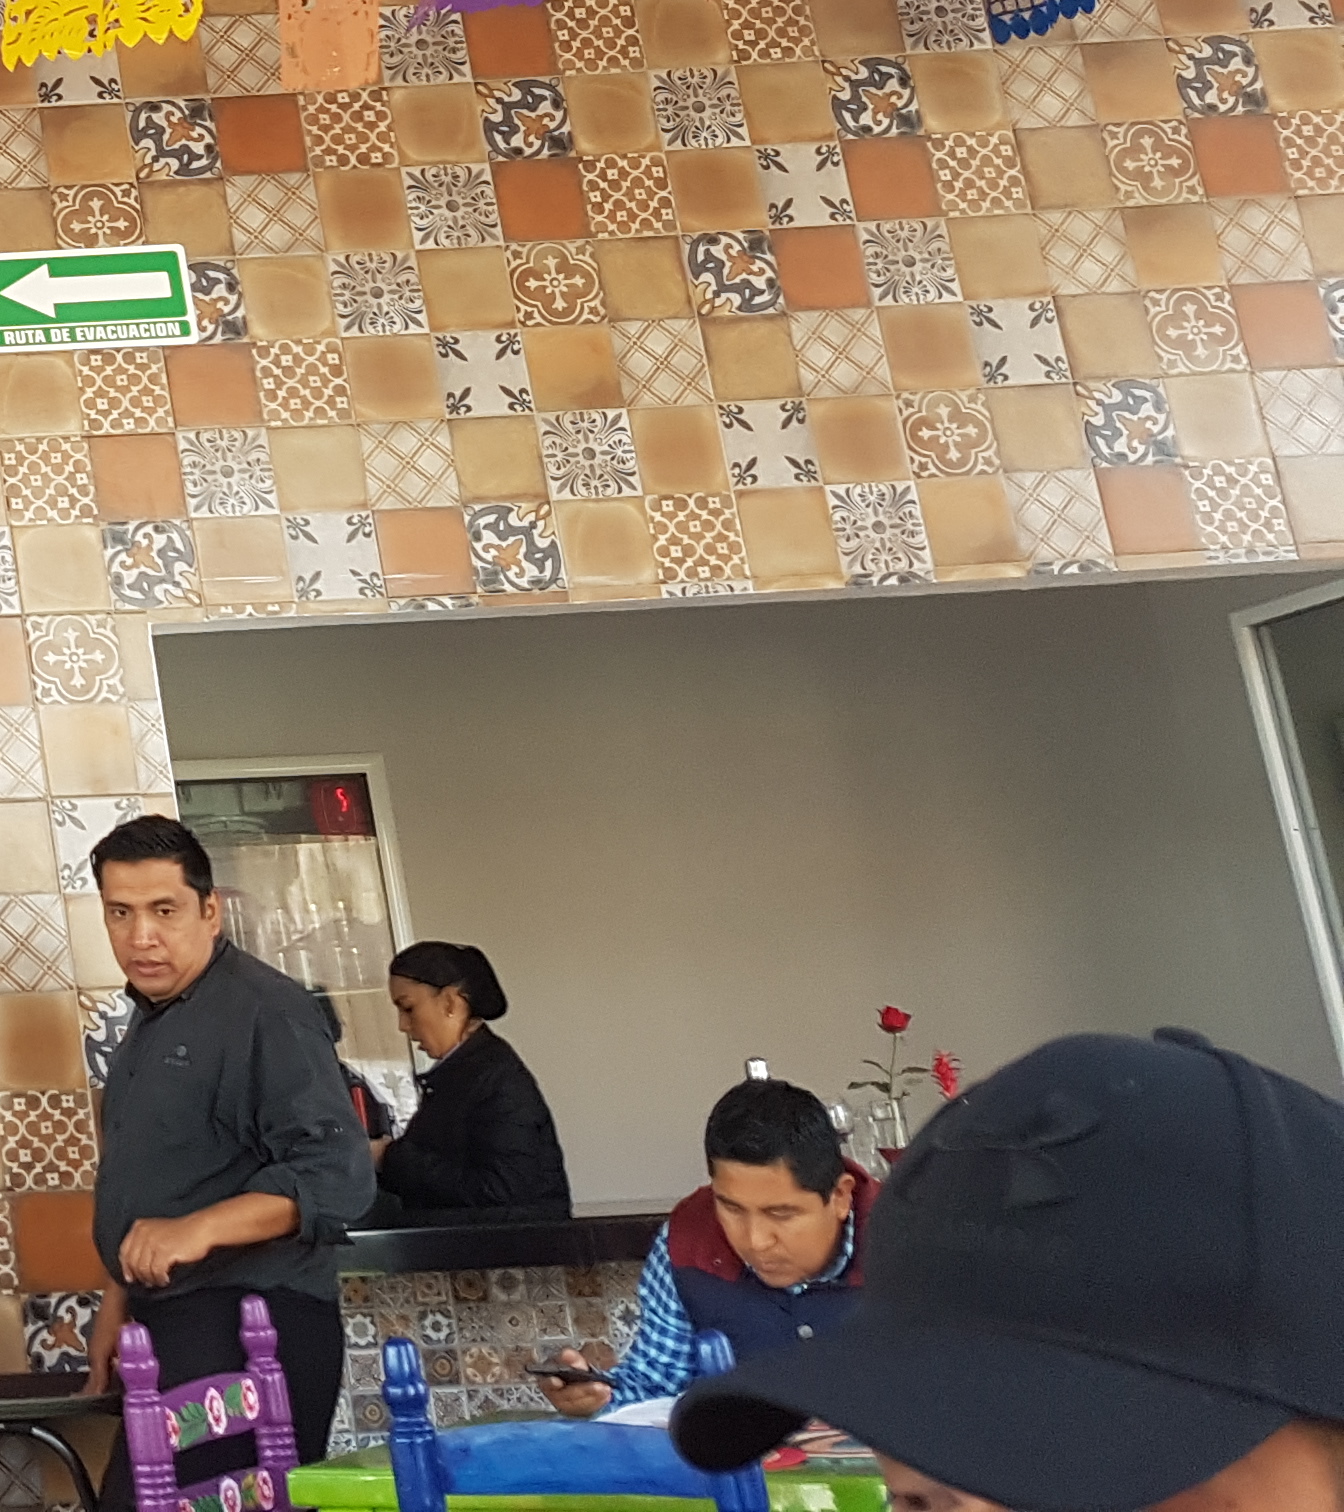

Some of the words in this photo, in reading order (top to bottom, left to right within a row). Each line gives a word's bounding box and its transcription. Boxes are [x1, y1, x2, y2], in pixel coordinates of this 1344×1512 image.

[4, 329, 46, 345] RUTA
[51, 327, 72, 343] DE
[75, 322, 181, 341] EVACUACION
